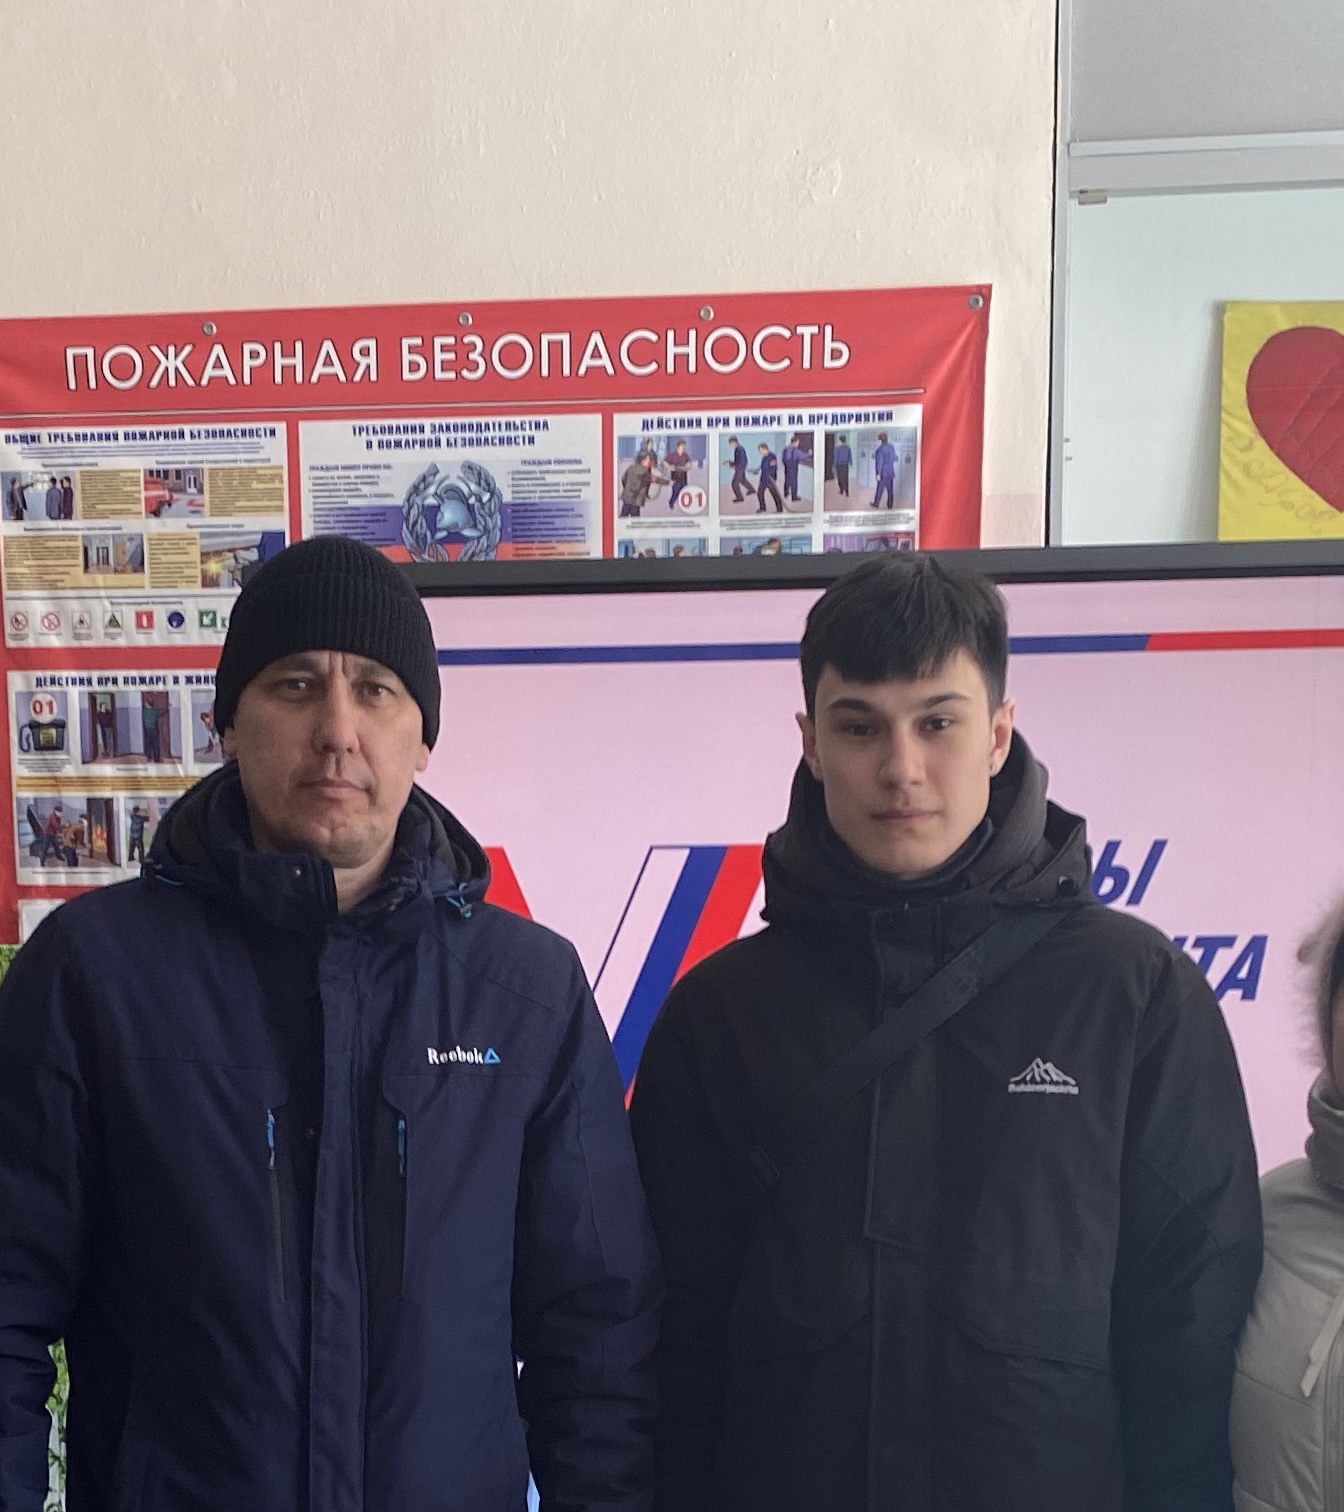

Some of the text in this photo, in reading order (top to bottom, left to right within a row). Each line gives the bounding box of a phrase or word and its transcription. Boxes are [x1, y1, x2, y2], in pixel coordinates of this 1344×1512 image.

[64, 324, 852, 391] ПОЖАРНАЯ БЕЗОПАСНОСТЬ
[351, 419, 550, 437] ТРЕБОВАНИЯ ЗАКОНОДАТЕЛЬСТВА
[641, 415, 702, 431] ДЕЙСТВИЯ
[706, 415, 730, 428] ПРИ
[734, 414, 783, 427] ПОЖАРЕ
[787, 413, 803, 426] НА
[3, 426, 278, 446] ОБЩИЕ ТРЕБОВАНИЯ ПОЖАРНОЙ БЕЗОПАСНОСТИ
[377, 436, 442, 450] ПОЖАРНОЙ
[445, 434, 536, 448] БЕЗОПАСНОСТИ
[679, 490, 704, 509] 01
[35, 675, 93, 688] ДЕЙСТВИЯ
[97, 675, 119, 687] ПРИ
[123, 674, 167, 687] ПОЖАРЕ
[31, 699, 55, 715] 01
[1087, 838, 1169, 906] Ы
[1172, 934, 1269, 1002] ТА
[427, 1045, 484, 1065] Reebok
